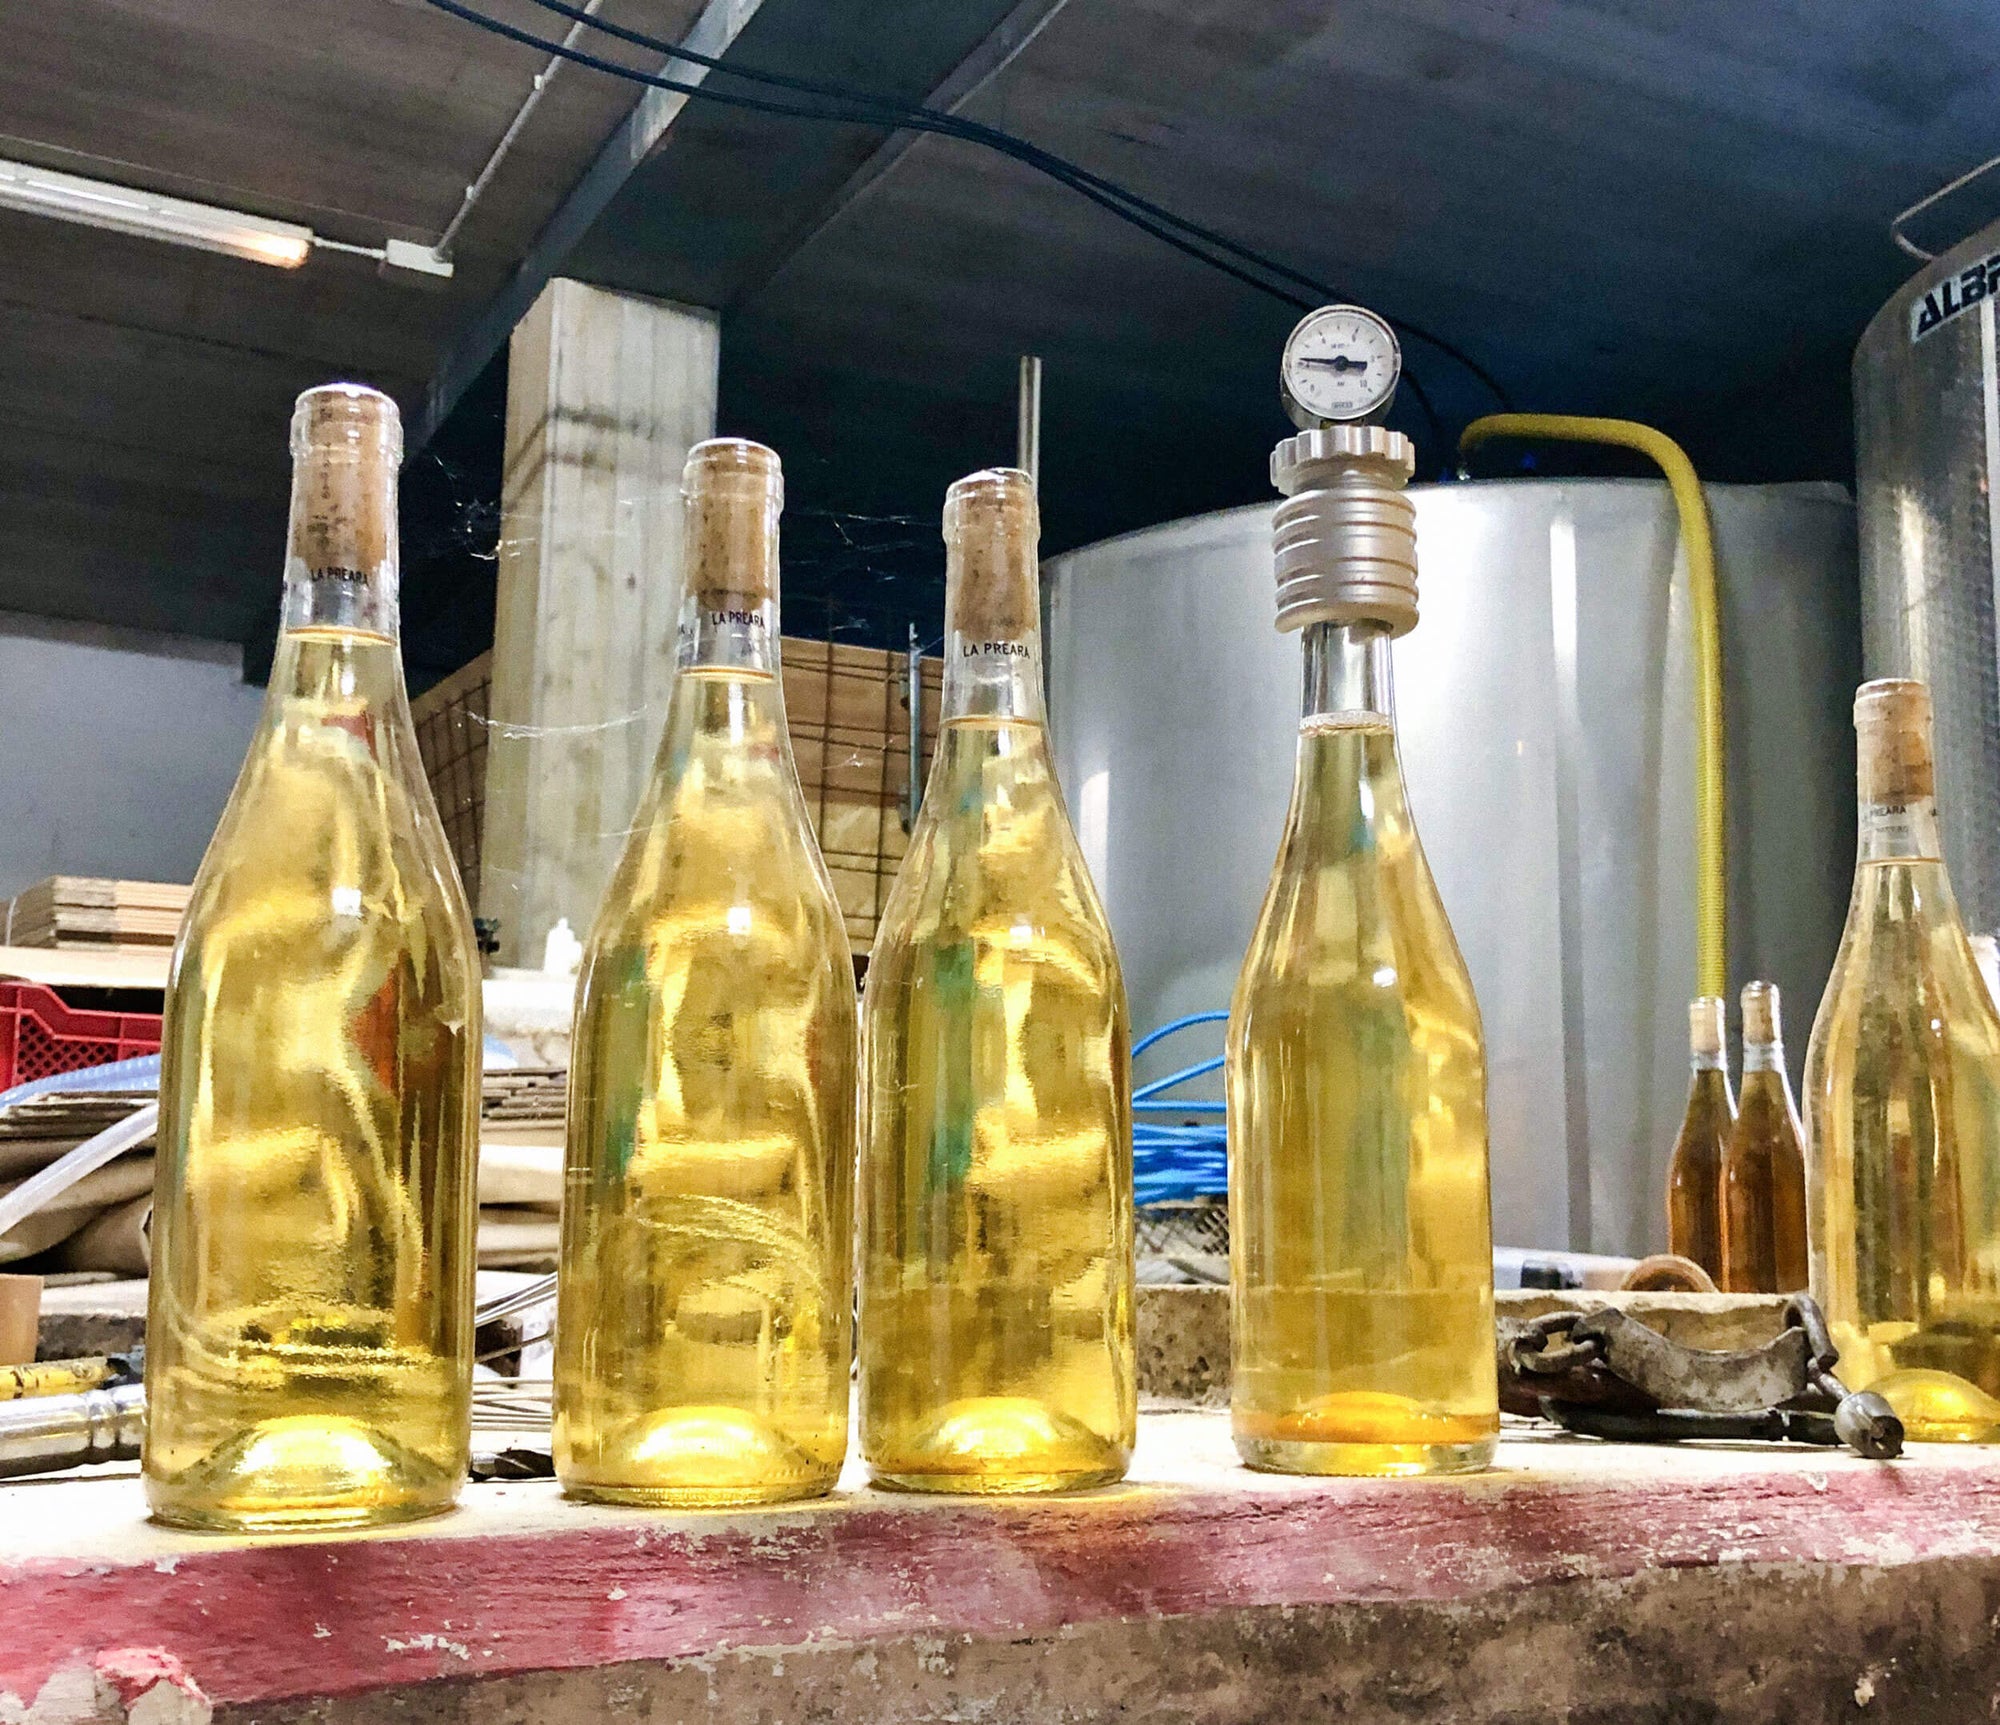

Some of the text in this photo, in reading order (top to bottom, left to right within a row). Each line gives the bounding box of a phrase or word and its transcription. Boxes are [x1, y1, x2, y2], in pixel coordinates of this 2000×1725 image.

[310, 567, 324, 582] LA
[712, 610, 765, 630] LA PREARA
[963, 643, 1031, 660] LA PREARA
